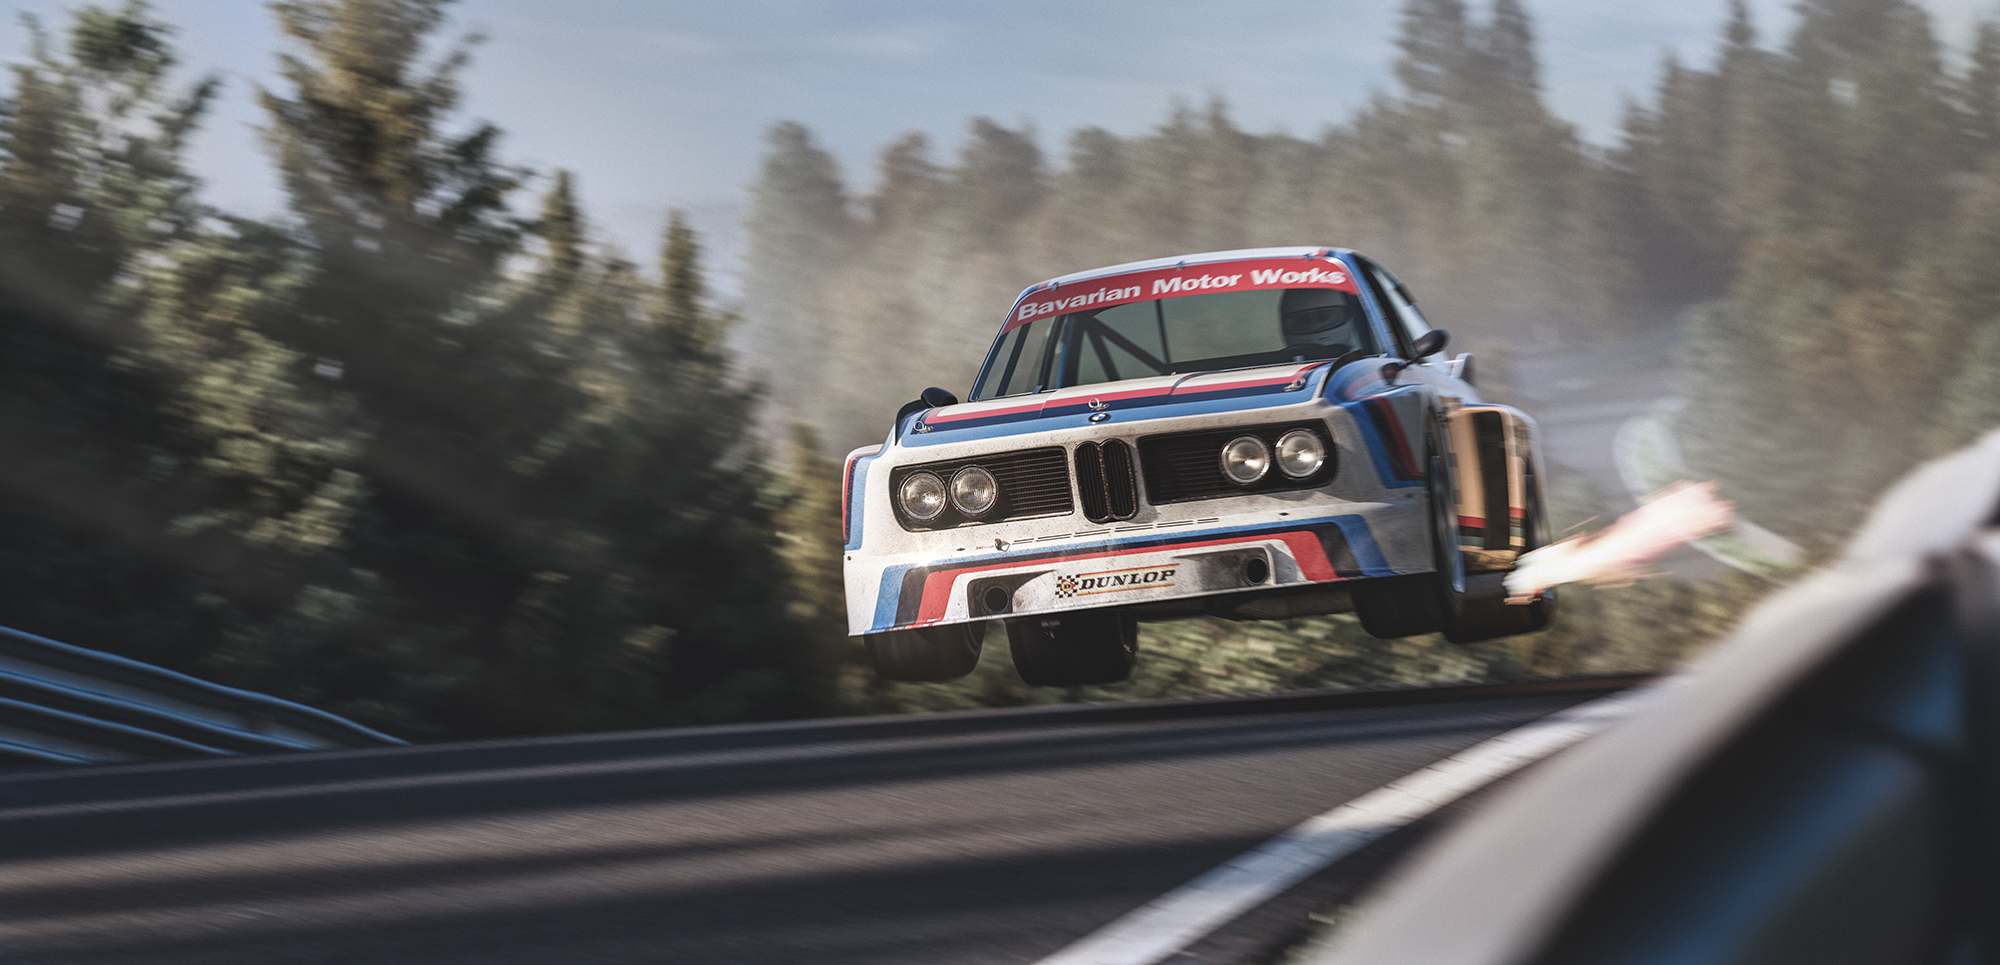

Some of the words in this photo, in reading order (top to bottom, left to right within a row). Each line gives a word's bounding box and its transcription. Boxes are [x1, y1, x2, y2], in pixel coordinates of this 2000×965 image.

[1016, 284, 1141, 321] Bavarian
[1152, 272, 1242, 295] Motor
[1249, 267, 1347, 285] Works
[1079, 569, 1175, 590] DUNLOP
